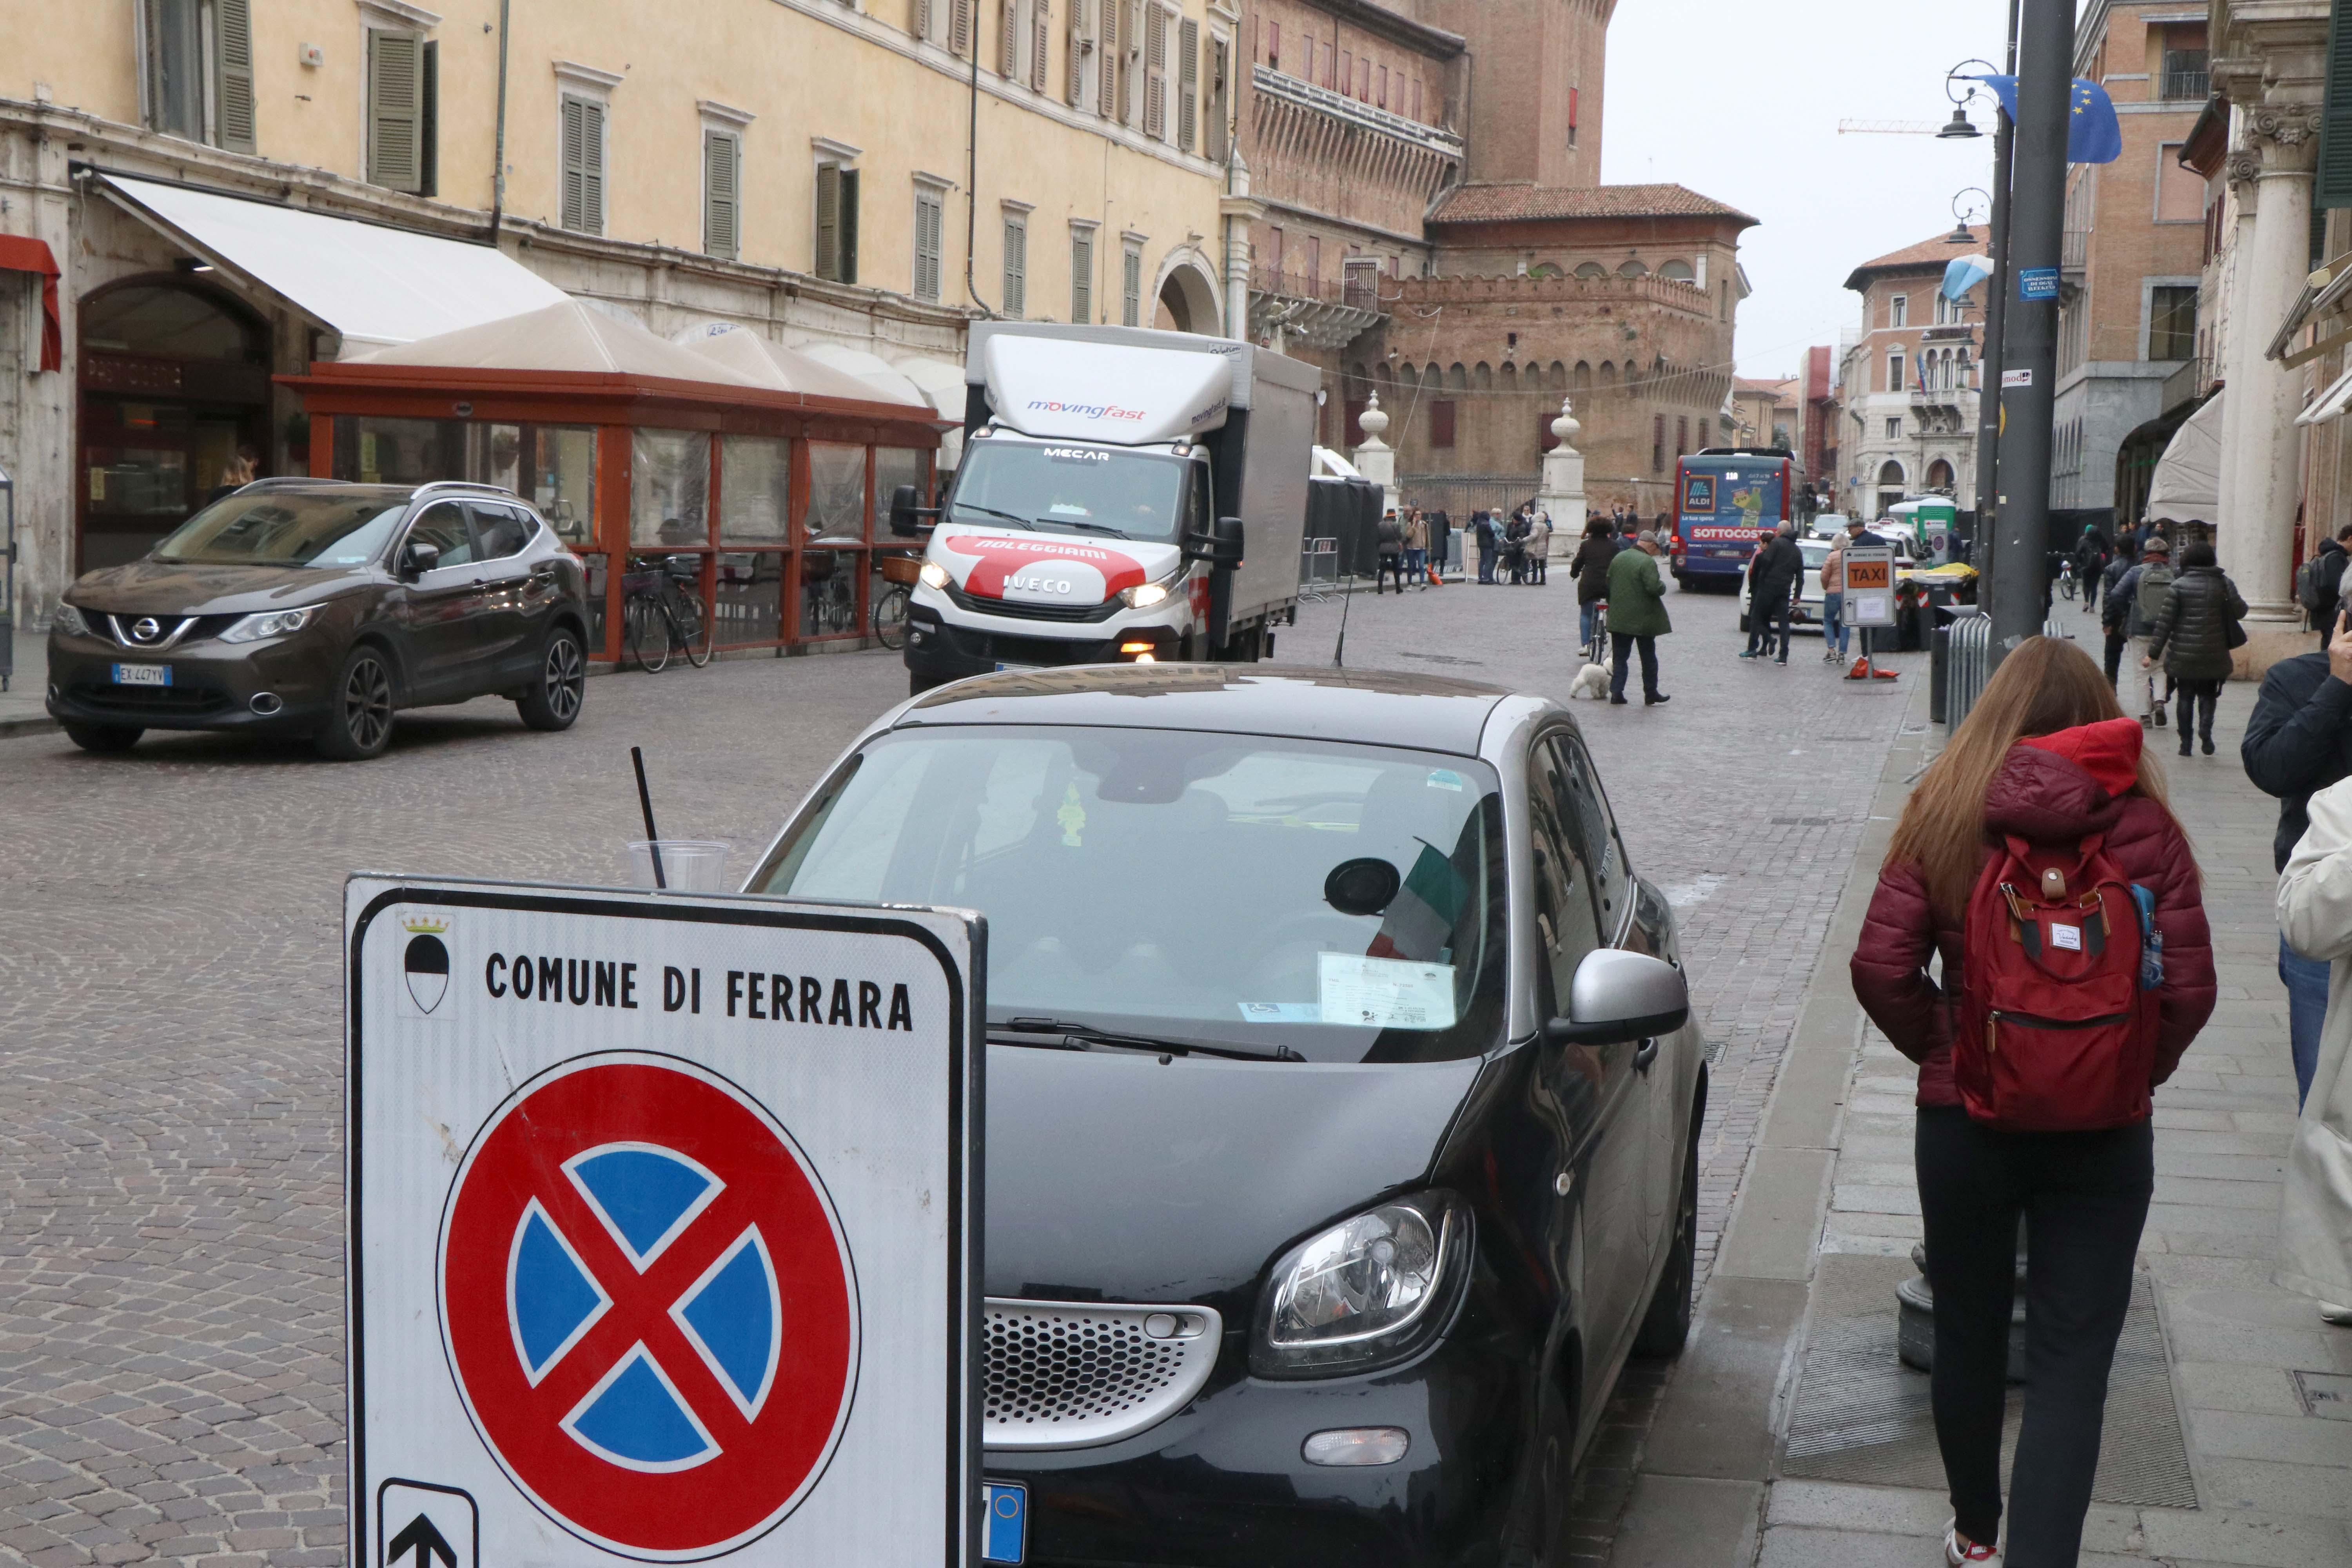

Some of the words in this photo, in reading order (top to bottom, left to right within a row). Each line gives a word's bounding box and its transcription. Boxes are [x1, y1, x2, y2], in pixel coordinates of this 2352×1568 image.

[1027, 401, 1147, 420] movingfast
[1043, 448, 1109, 461] MECAR
[975, 540, 1107, 560] NOLEGGIAMI
[1851, 568, 1886, 581] TAXI
[1003, 575, 1071, 594] IVECO
[485, 953, 638, 1009] COMUNE
[664, 967, 700, 1014] DI
[727, 970, 913, 1032] FERRARA
